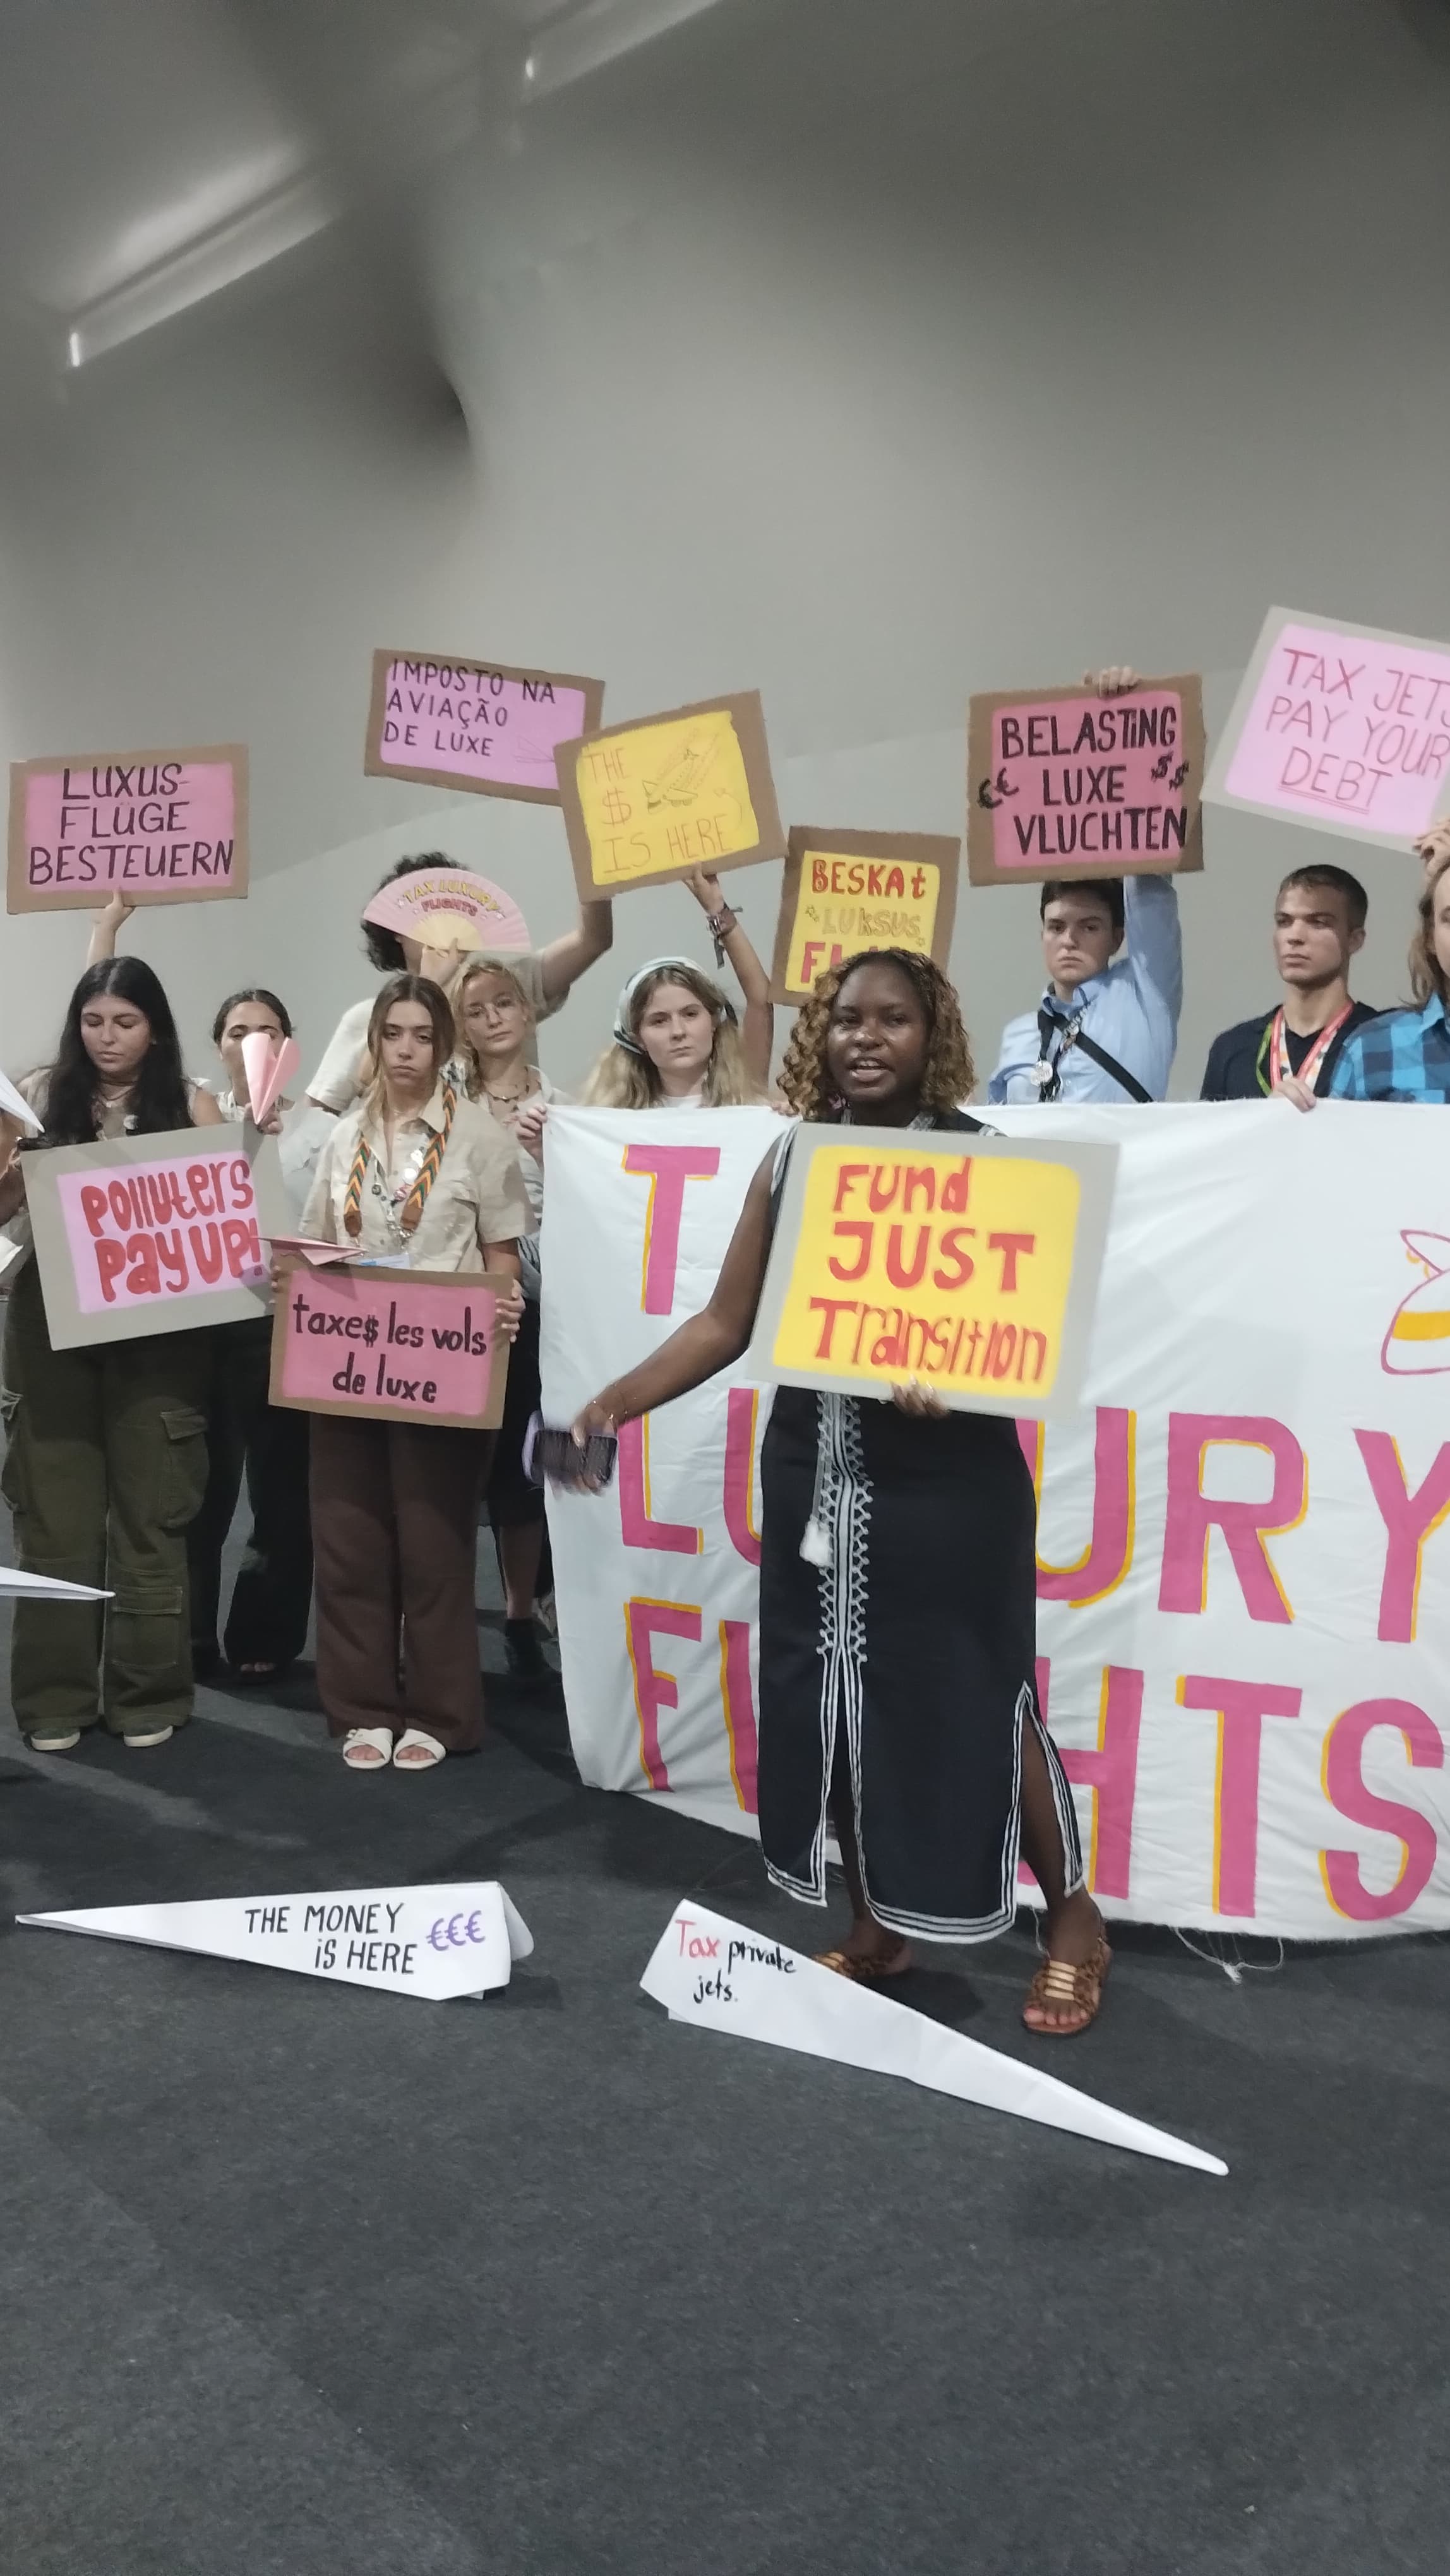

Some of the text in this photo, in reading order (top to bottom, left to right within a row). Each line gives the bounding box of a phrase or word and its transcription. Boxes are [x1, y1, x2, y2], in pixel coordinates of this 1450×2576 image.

[391, 658, 556, 704] IMPOSTO NA
[1283, 648, 1366, 701] TAX
[387, 688, 508, 729] AVIAÇÃO
[1000, 705, 1177, 760] BELASTING
[384, 720, 494, 757] DE LUXE
[1265, 695, 1450, 780] PAY YOUR
[582, 747, 630, 784] THE
[1042, 763, 1127, 806] LUXE
[1281, 746, 1393, 808] DEBT
[602, 787, 632, 828] $
[1013, 805, 1188, 856] VLUCHTEN
[29, 838, 234, 885] BESTEUERN
[602, 813, 733, 874] IS HERE
[403, 878, 500, 912] TAX LUXURY
[828, 1221, 1035, 1293] JUST
[386, 1301, 424, 1349] les
[432, 1306, 487, 1356] vols
[332, 1351, 437, 1404] de luxe
[617, 1387, 1450, 1644] LURY
[244, 1902, 405, 1934] THE MONEY
[346, 1941, 417, 1974] HERE
[674, 1919, 796, 1974] Tax private
